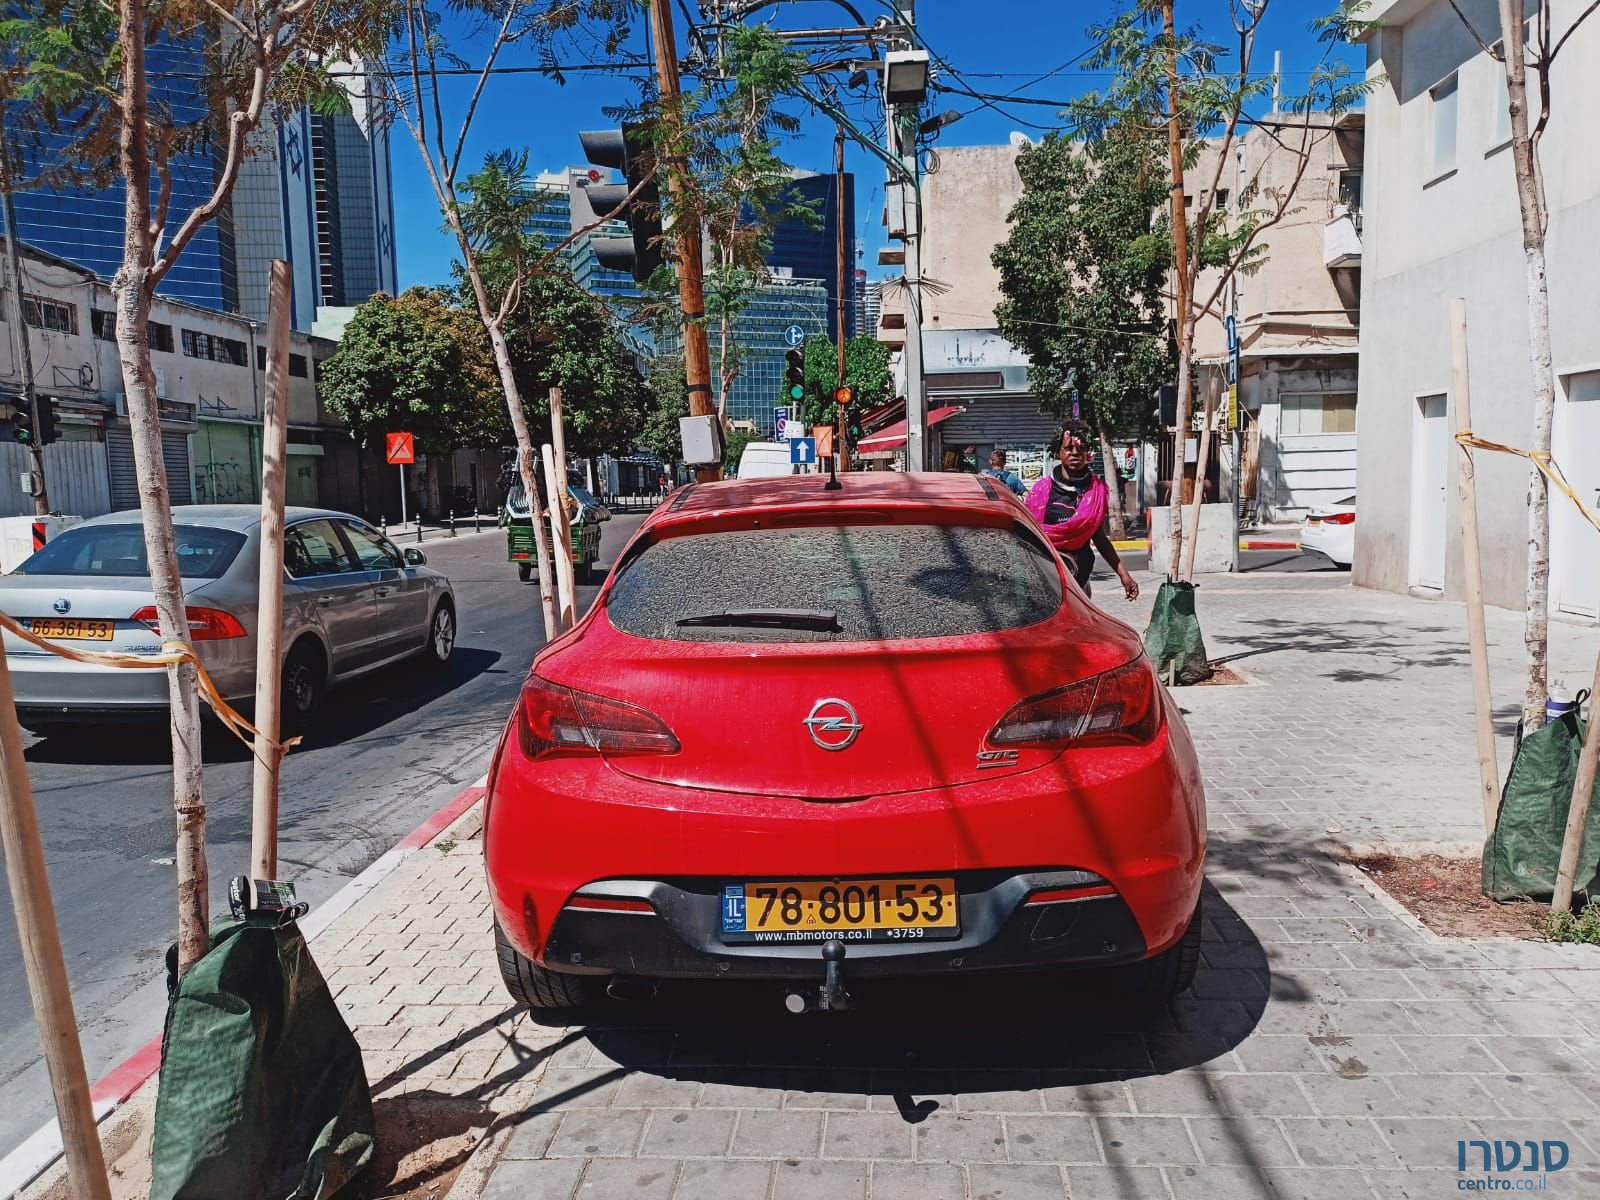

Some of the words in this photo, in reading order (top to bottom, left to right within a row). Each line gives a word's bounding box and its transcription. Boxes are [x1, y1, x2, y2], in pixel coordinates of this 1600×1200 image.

[976, 749, 1019, 761] GTC
[728, 898, 742, 917] IL
[754, 929, 873, 941] www.mbmotors.co.il
